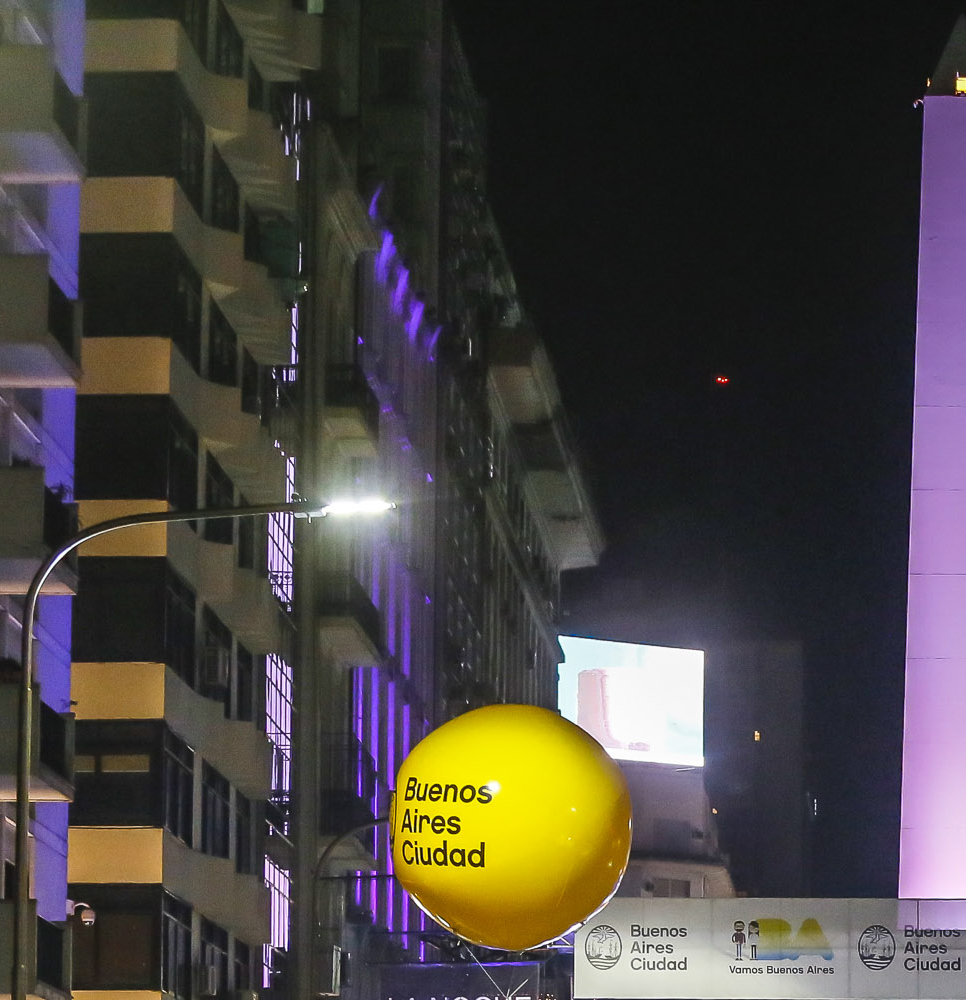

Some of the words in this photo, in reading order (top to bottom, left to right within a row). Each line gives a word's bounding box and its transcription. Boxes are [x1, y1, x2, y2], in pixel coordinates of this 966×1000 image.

[404, 777, 493, 804] Buenos
[401, 809, 461, 835] Aires
[402, 840, 486, 867] Ciudad
[631, 924, 688, 938] Buenos
[904, 924, 961, 938] Buenos
[631, 942, 674, 954] Aires
[904, 942, 948, 954] Aires
[630, 957, 688, 971] Ciudad
[729, 965, 764, 974] Vamos
[766, 965, 804, 974] Buenos
[806, 965, 834, 974] Aires
[904, 957, 961, 971] Ciudad
